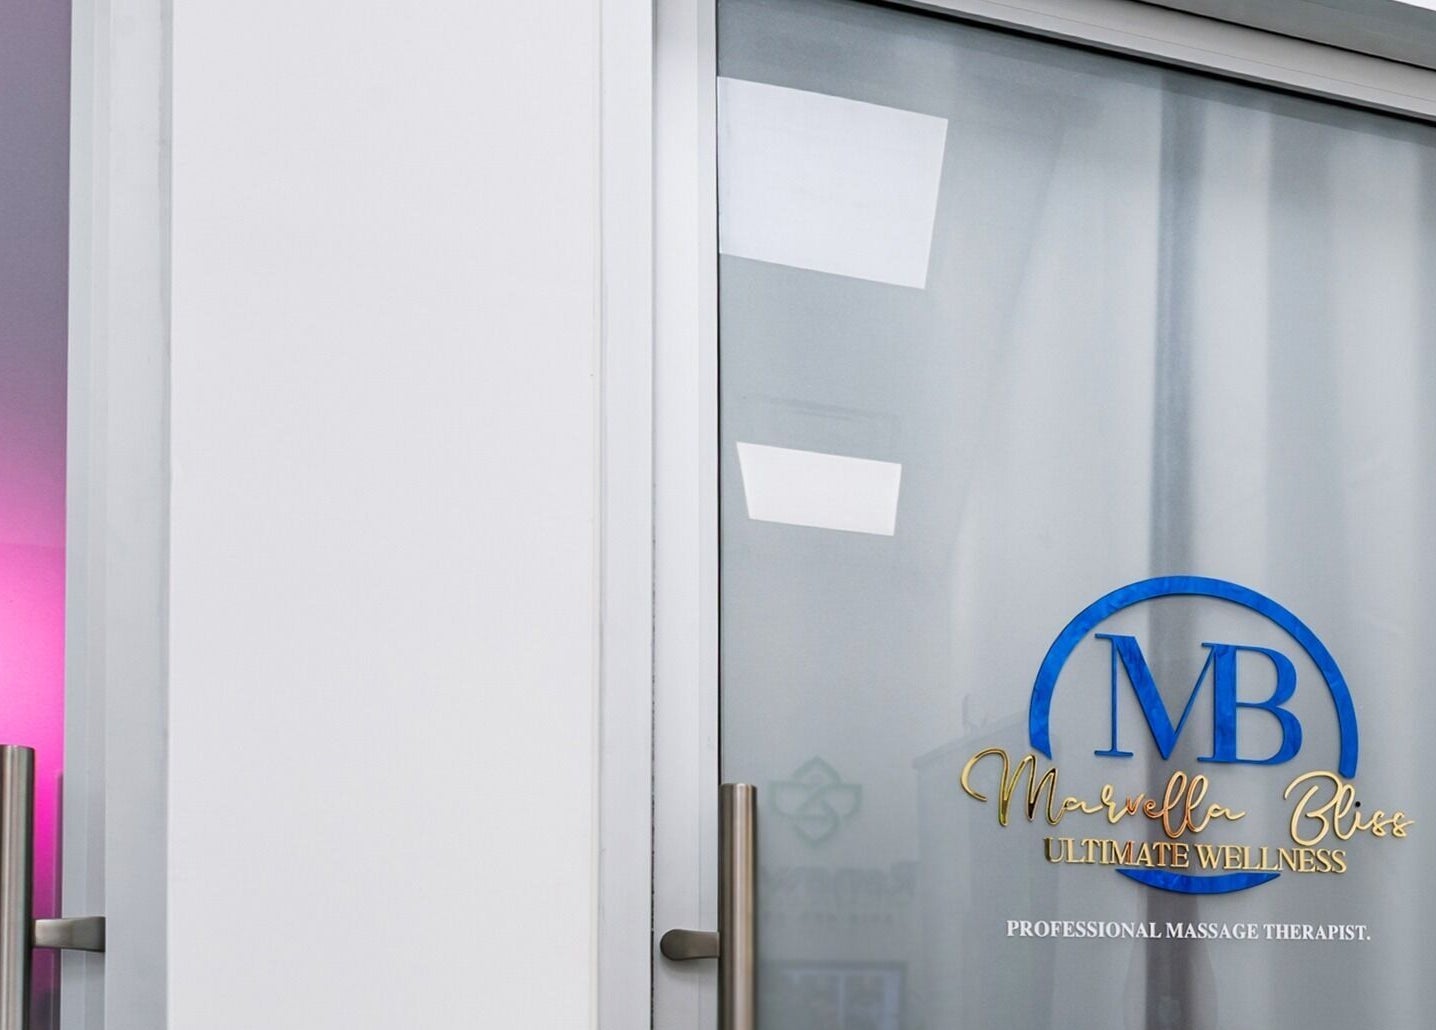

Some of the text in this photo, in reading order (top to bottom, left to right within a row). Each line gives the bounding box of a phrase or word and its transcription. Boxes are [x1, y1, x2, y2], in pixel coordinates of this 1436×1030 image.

[1094, 633, 1303, 765] MB
[960, 747, 1415, 847] Marvella Bliss
[1043, 836, 1347, 874] ULTIMATE WELLNESS
[1006, 919, 1371, 941] PROFESSIONAL MASSAGE THERAPIST.
